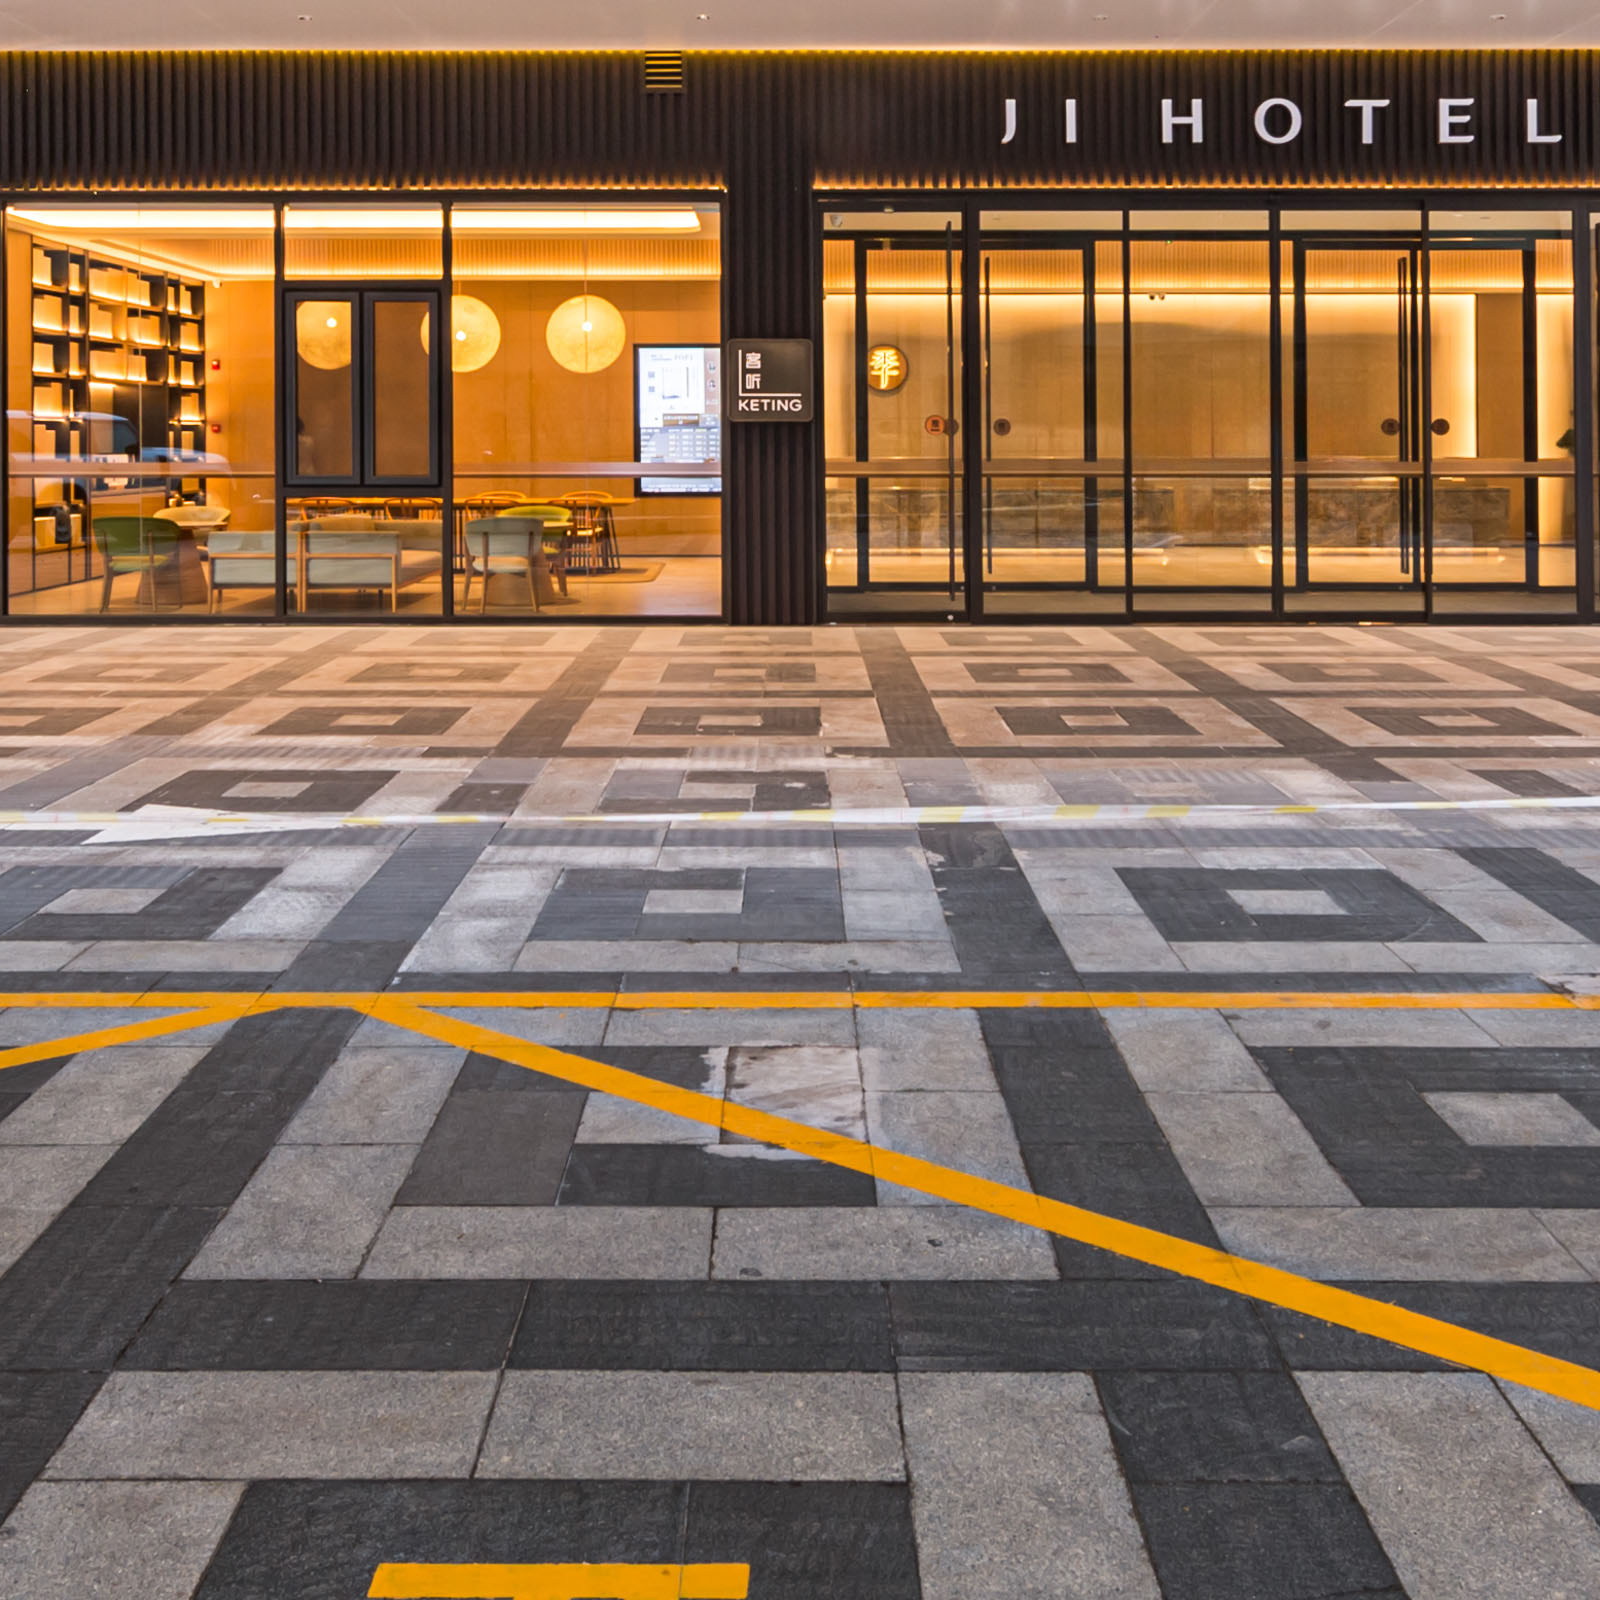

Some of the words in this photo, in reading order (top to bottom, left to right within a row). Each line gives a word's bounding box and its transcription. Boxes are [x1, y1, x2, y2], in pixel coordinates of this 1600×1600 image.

[1000, 97, 1077, 145] JI
[1160, 97, 1563, 145] HOTEL
[738, 399, 802, 412] KETING
